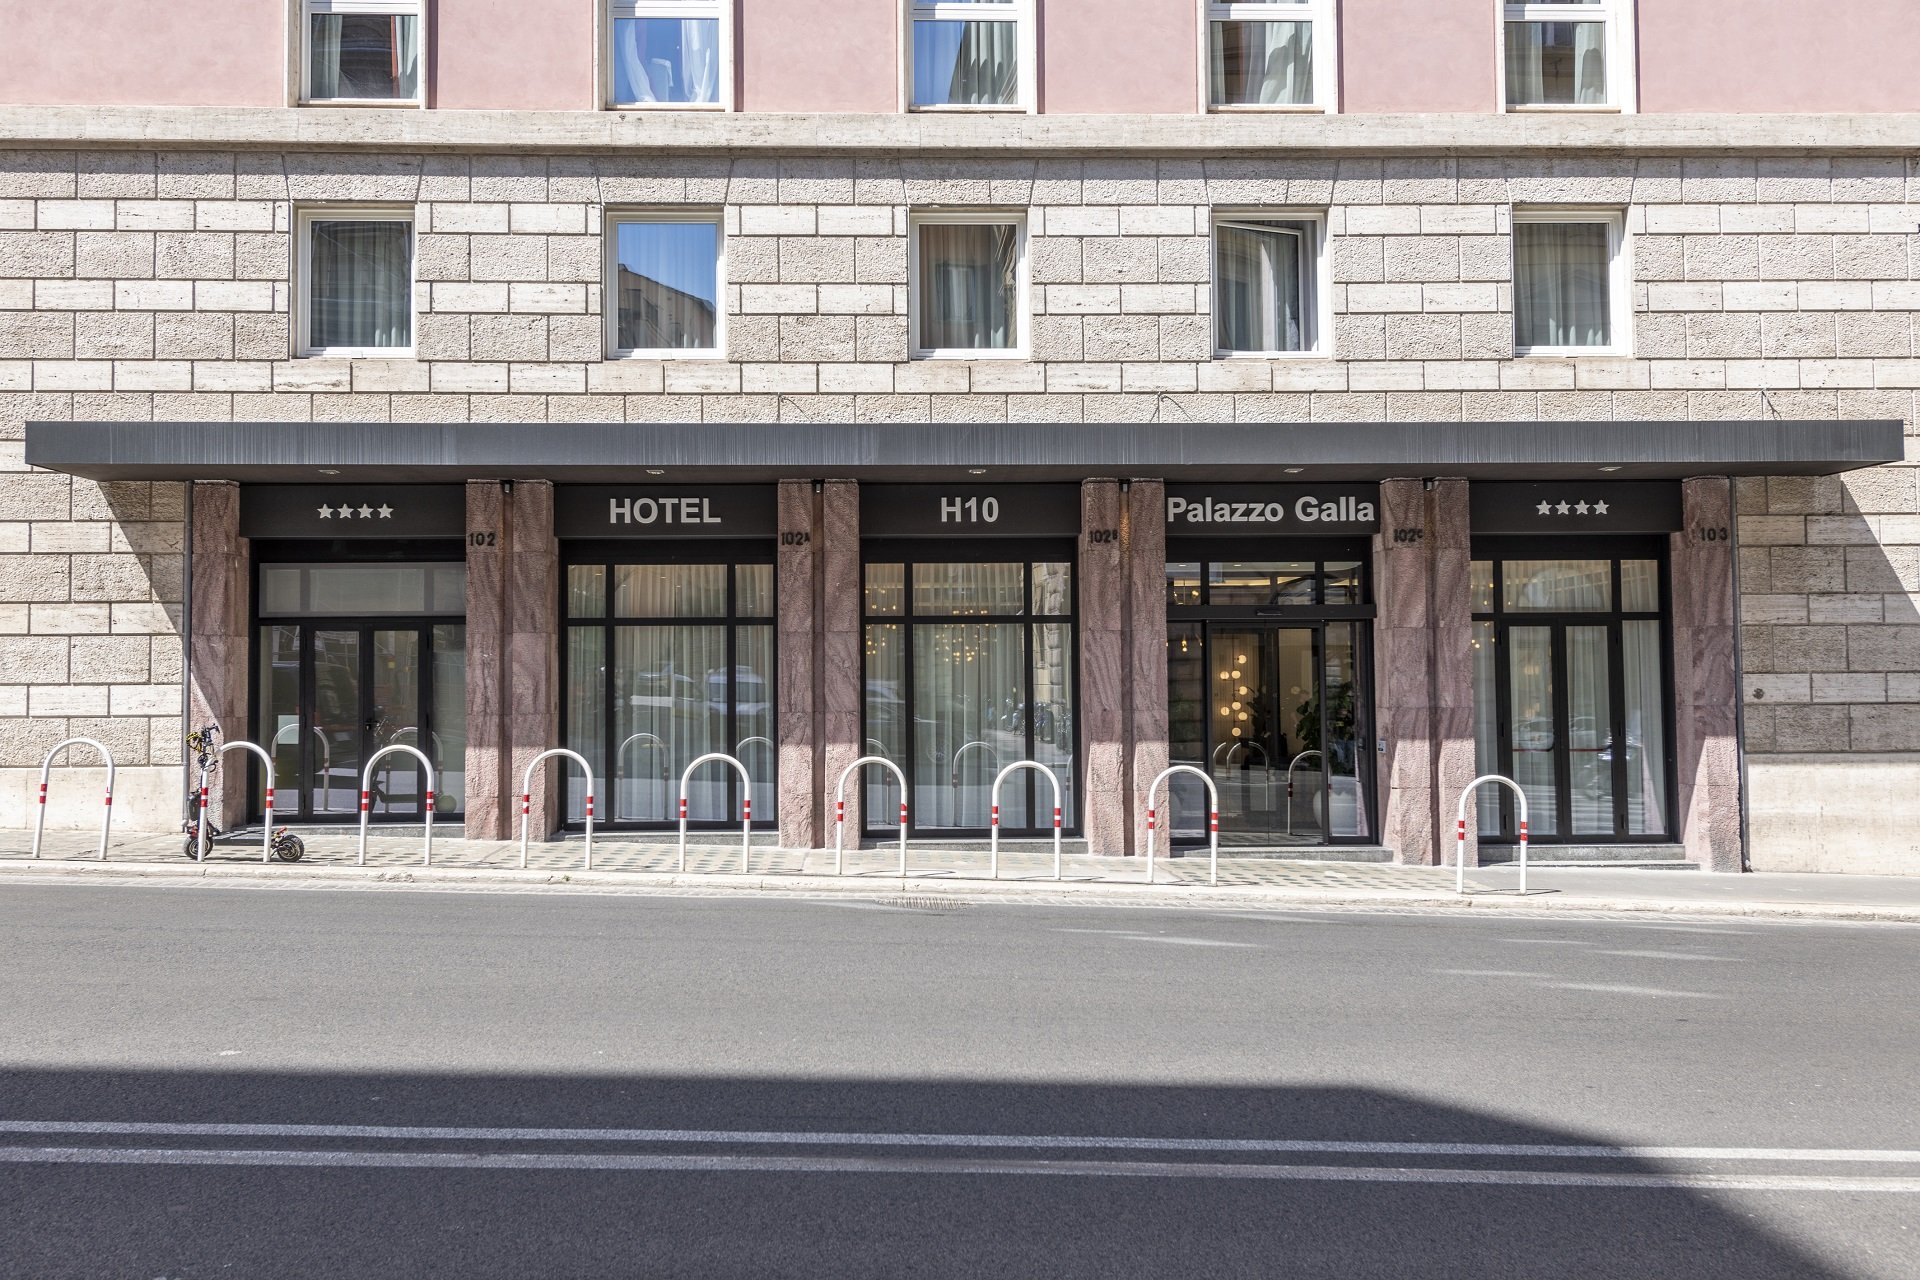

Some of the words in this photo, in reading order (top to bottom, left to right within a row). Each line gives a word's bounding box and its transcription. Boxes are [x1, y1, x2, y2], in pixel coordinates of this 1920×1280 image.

[610, 498, 721, 523] HOTEL
[941, 497, 999, 522] H10
[1167, 497, 1284, 522] Palazzo
[1295, 496, 1375, 521] Galla
[468, 532, 496, 546] 102
[1701, 527, 1728, 541] 103
